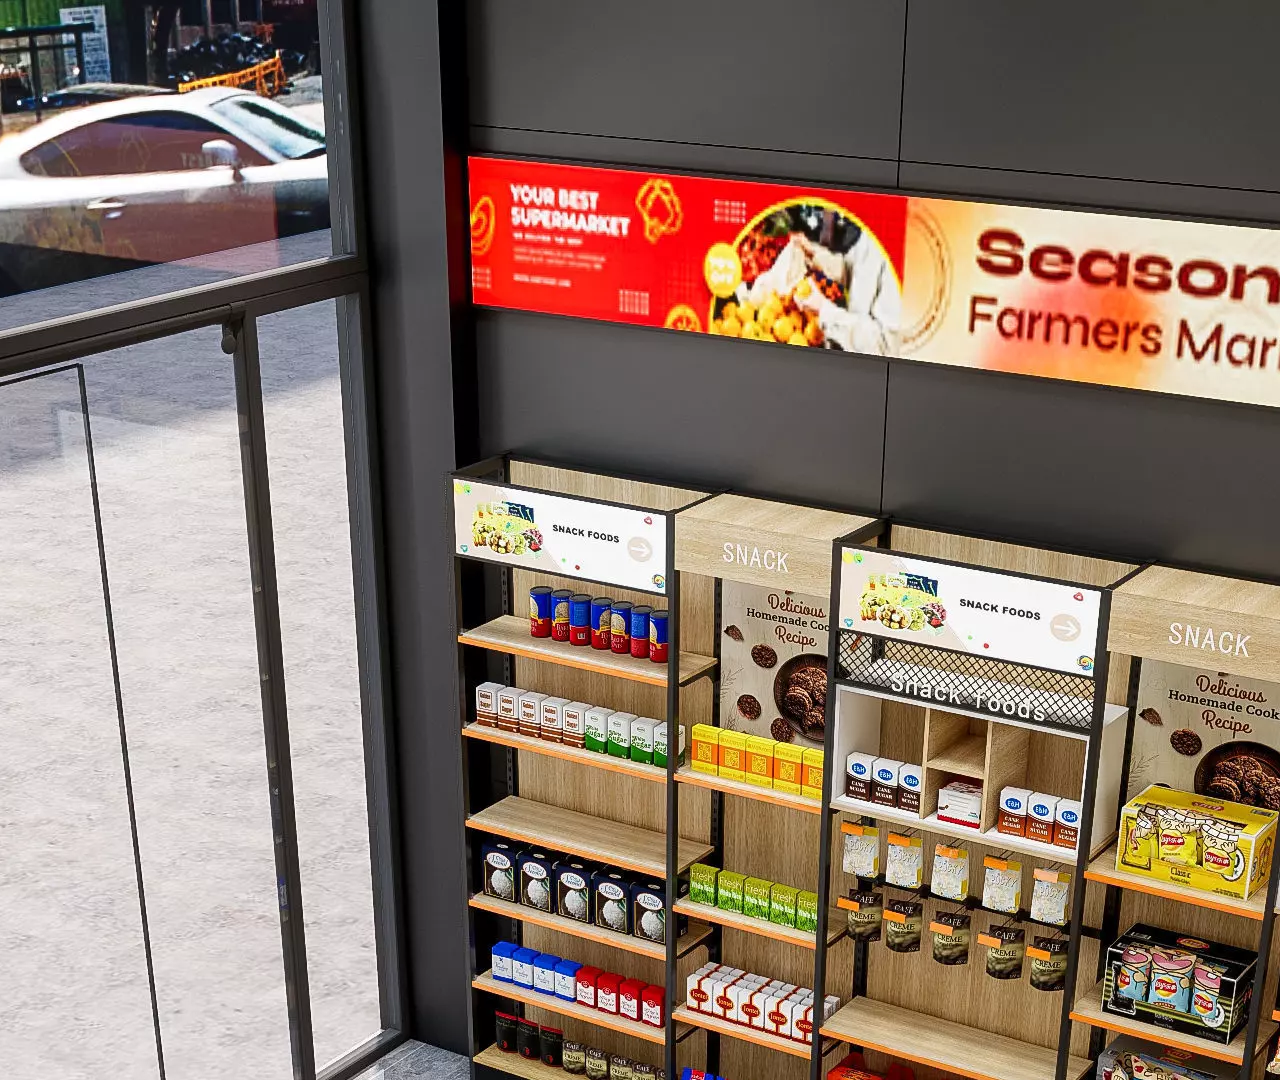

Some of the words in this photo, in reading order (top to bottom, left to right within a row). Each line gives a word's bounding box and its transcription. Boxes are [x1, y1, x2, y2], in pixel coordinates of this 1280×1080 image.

[510, 184, 555, 206] YOUR
[559, 189, 599, 211] BEST
[510, 207, 631, 237] SUPERMARKET
[968, 296, 1162, 357] Farmers
[552, 524, 585, 538] SNACK
[587, 530, 620, 544] FOODS
[722, 542, 789, 573] SNACK
[746, 607, 808, 629] Homemade
[767, 593, 826, 619] Delicious
[959, 598, 999, 614] SNACK
[1002, 605, 1041, 621] FOODS
[774, 625, 817, 650] Recipe
[1168, 622, 1251, 657] SNACK
[891, 671, 961, 706] Snack
[975, 689, 1046, 722] foods
[1168, 689, 1242, 713] Homemade
[1195, 674, 1267, 703] Delicious
[1201, 709, 1252, 739] Recipe
[691, 870, 714, 884] Fresh
[719, 876, 743, 890] Fresh
[745, 884, 769, 898] Fresh
[771, 890, 795, 904] Fresh
[798, 896, 817, 910] Fres
